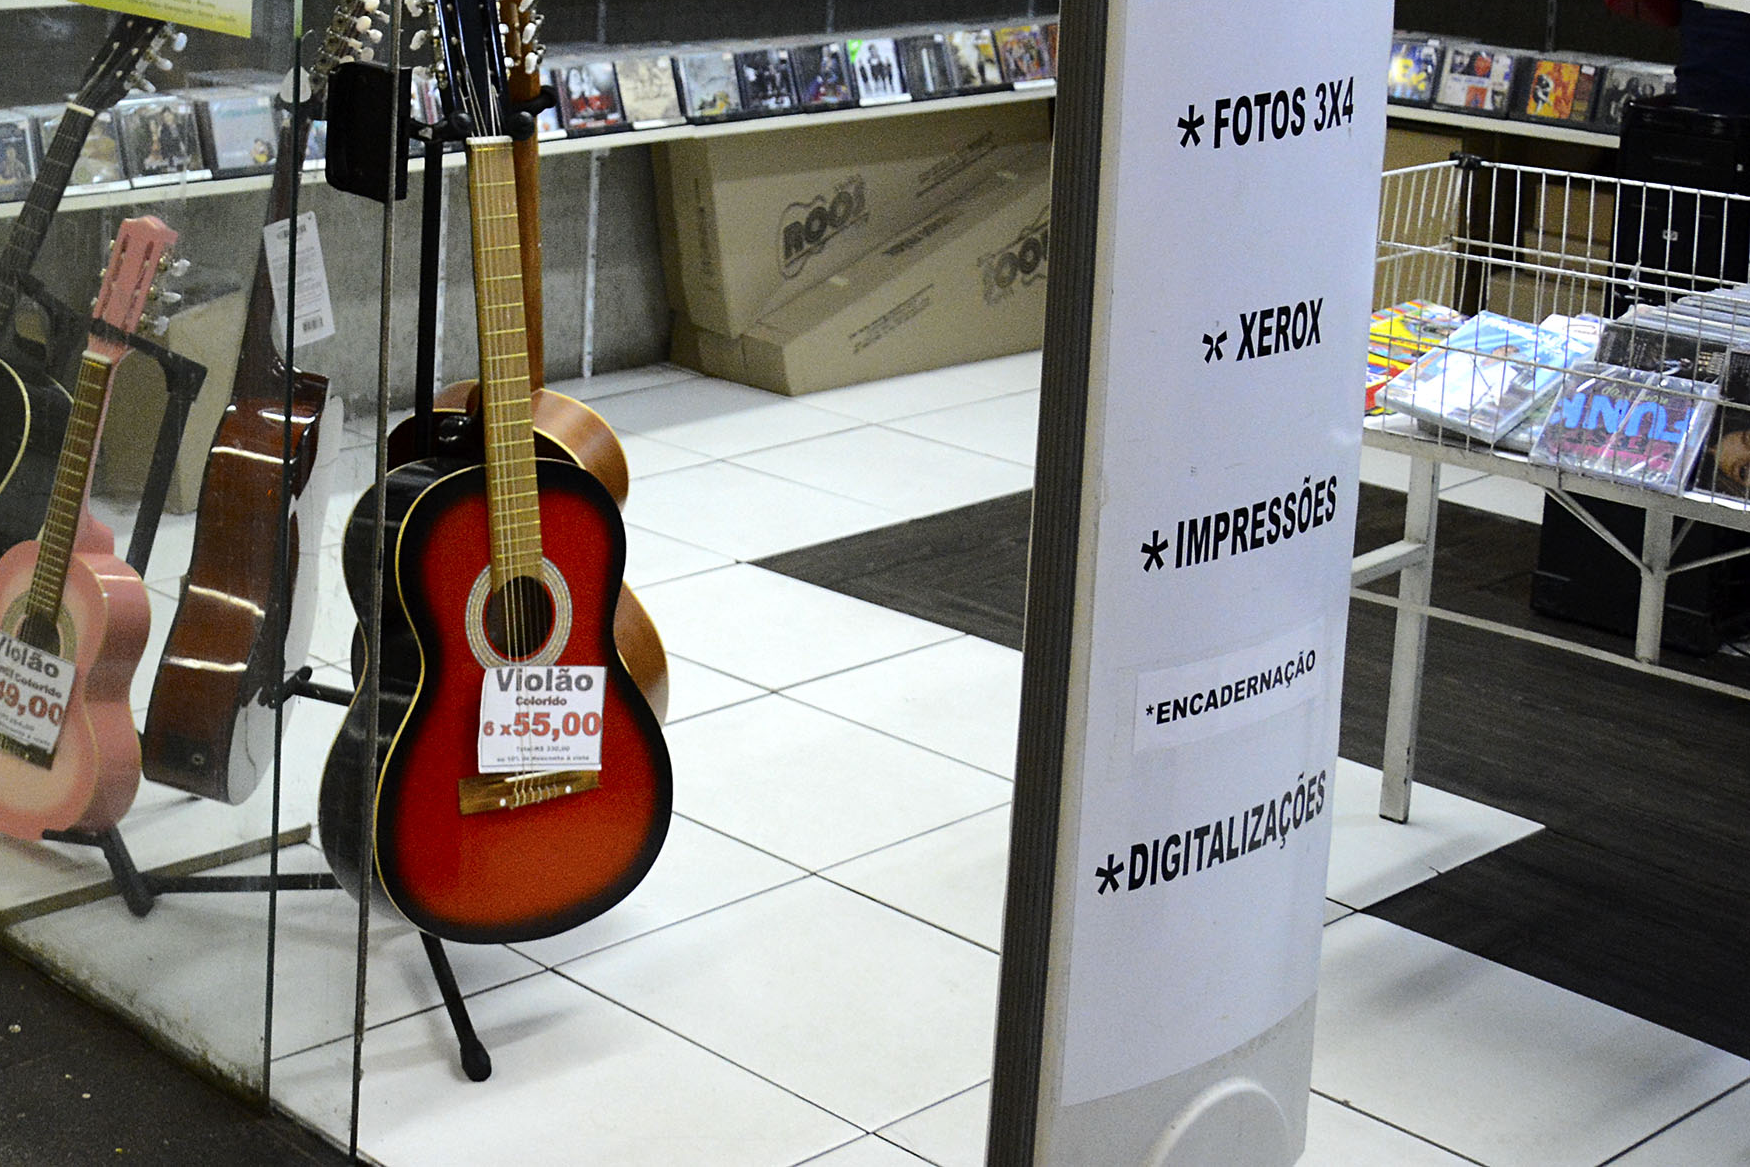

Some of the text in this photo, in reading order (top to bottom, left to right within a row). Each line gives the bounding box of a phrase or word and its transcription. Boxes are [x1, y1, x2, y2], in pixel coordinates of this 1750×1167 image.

[1213, 76, 1354, 149] FOTOS 3X4
[1235, 297, 1324, 362] XEROX
[1550, 393, 1696, 444] FUNK
[1175, 474, 1338, 569] IMPRESSÕES
[496, 667, 594, 693] Violão
[515, 696, 567, 706] Colorido
[1155, 649, 1316, 725] ENCADERNAÇÃO
[483, 721, 495, 737] 6
[513, 712, 602, 742] 55,00
[1127, 769, 1326, 892] DIGITALIZAÇÕES
